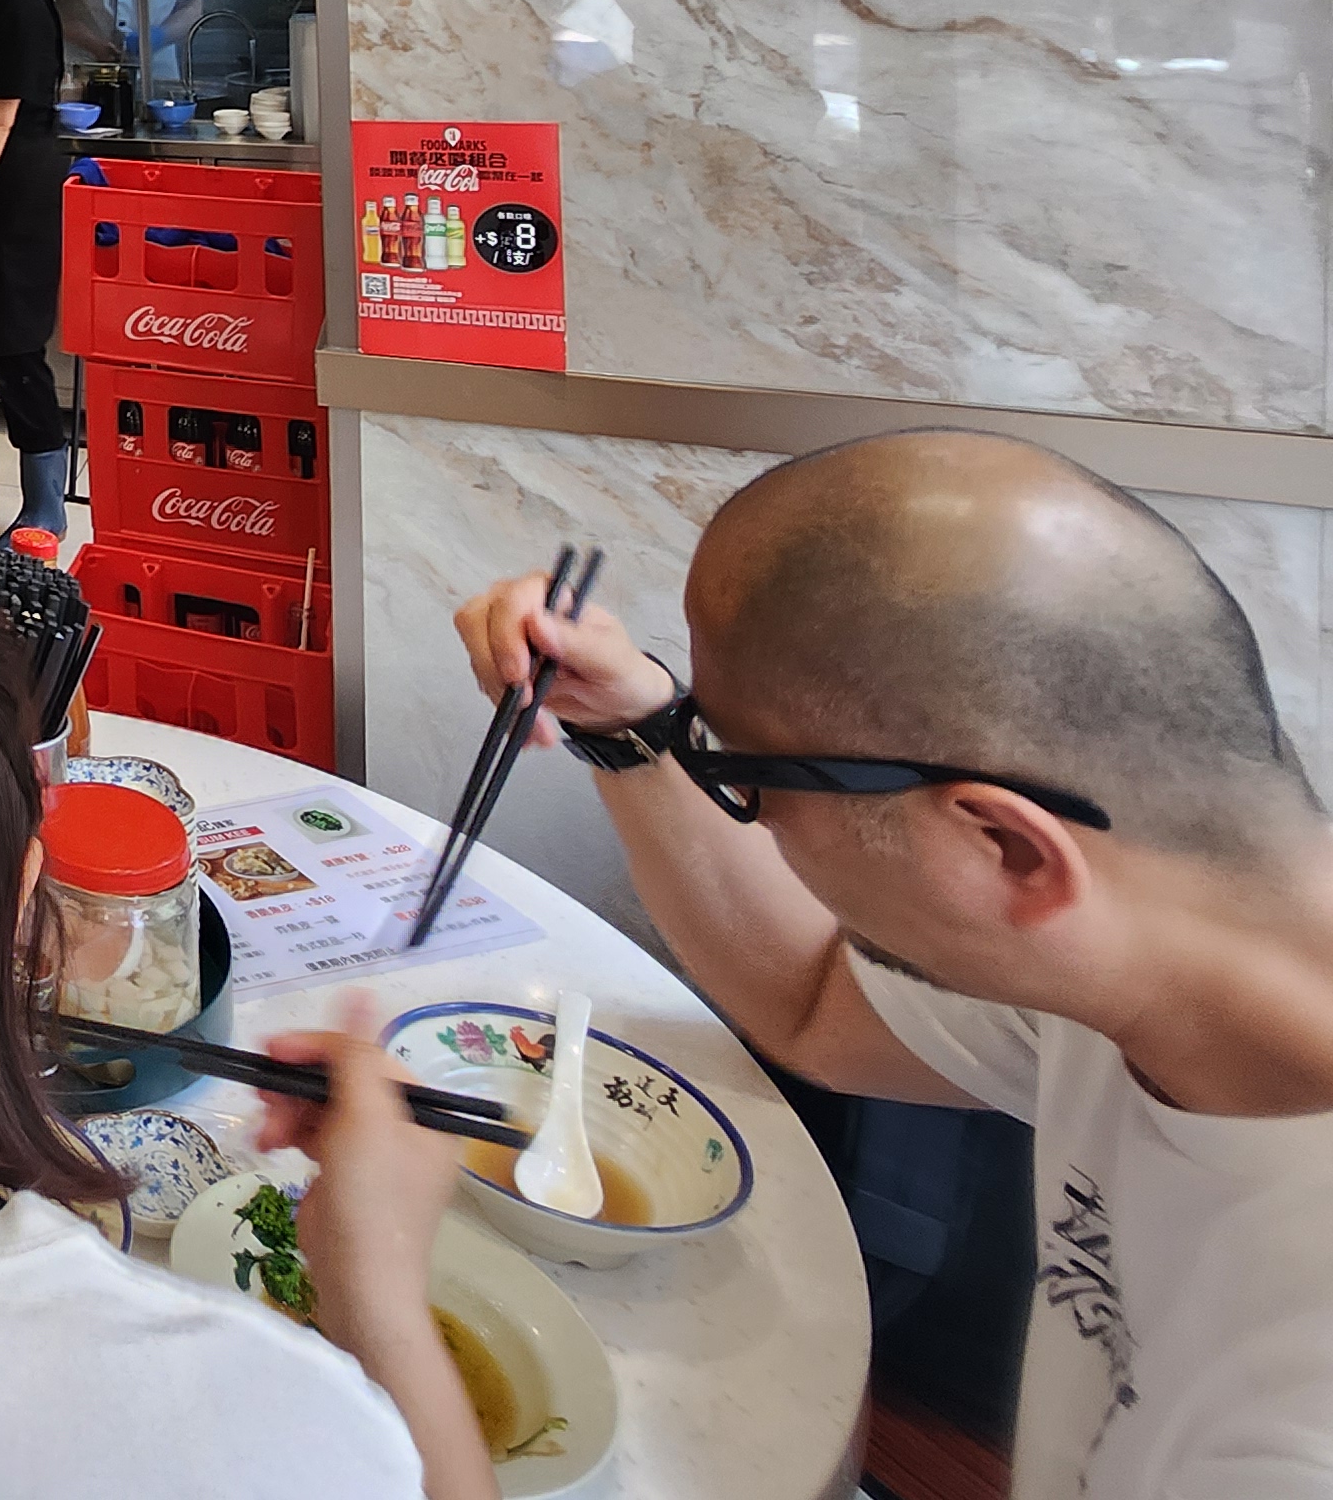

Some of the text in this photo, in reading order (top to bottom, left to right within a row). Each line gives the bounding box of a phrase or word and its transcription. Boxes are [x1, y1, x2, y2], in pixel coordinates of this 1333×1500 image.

[420, 139, 488, 151] FOODMARKS
[124, 305, 255, 353] Coca-Cola
[151, 487, 281, 537] Coca-Cola
